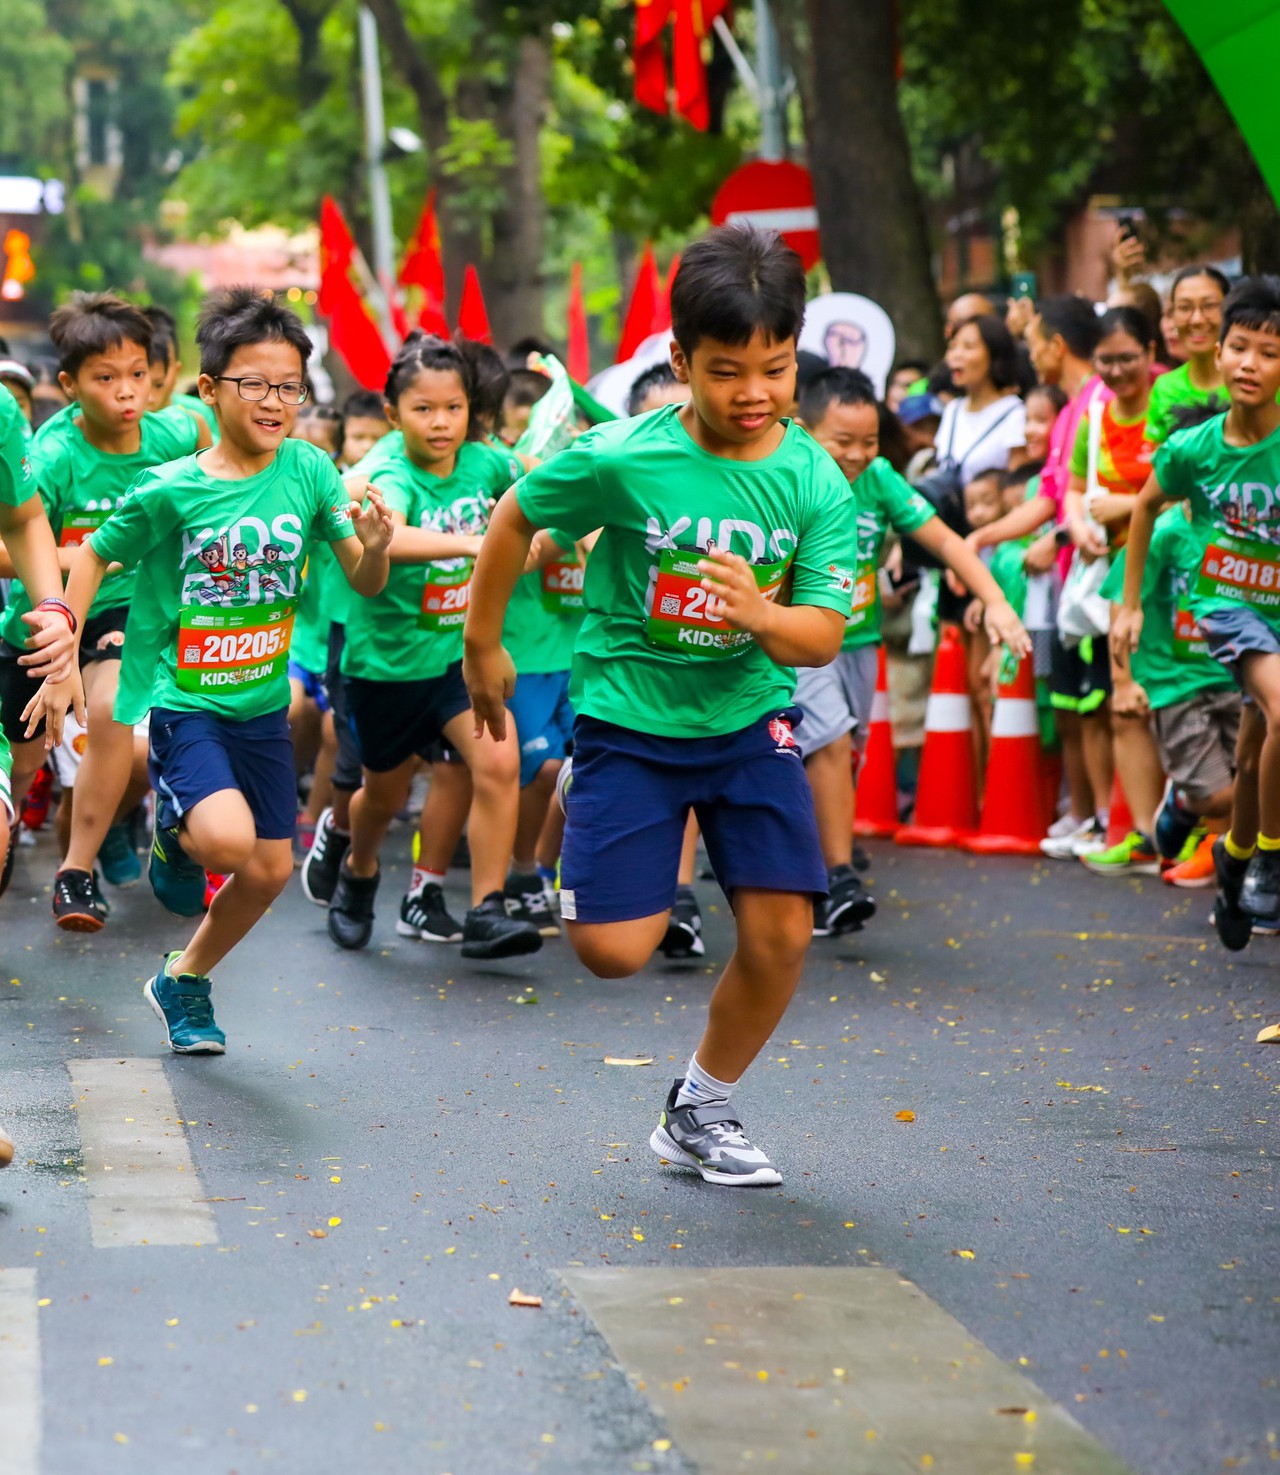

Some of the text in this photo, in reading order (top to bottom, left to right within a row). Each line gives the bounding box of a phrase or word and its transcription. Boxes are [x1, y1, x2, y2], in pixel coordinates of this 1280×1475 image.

[1201, 481, 1280, 519] KID
[179, 513, 303, 570] KDS
[202, 627, 282, 662] 20205
